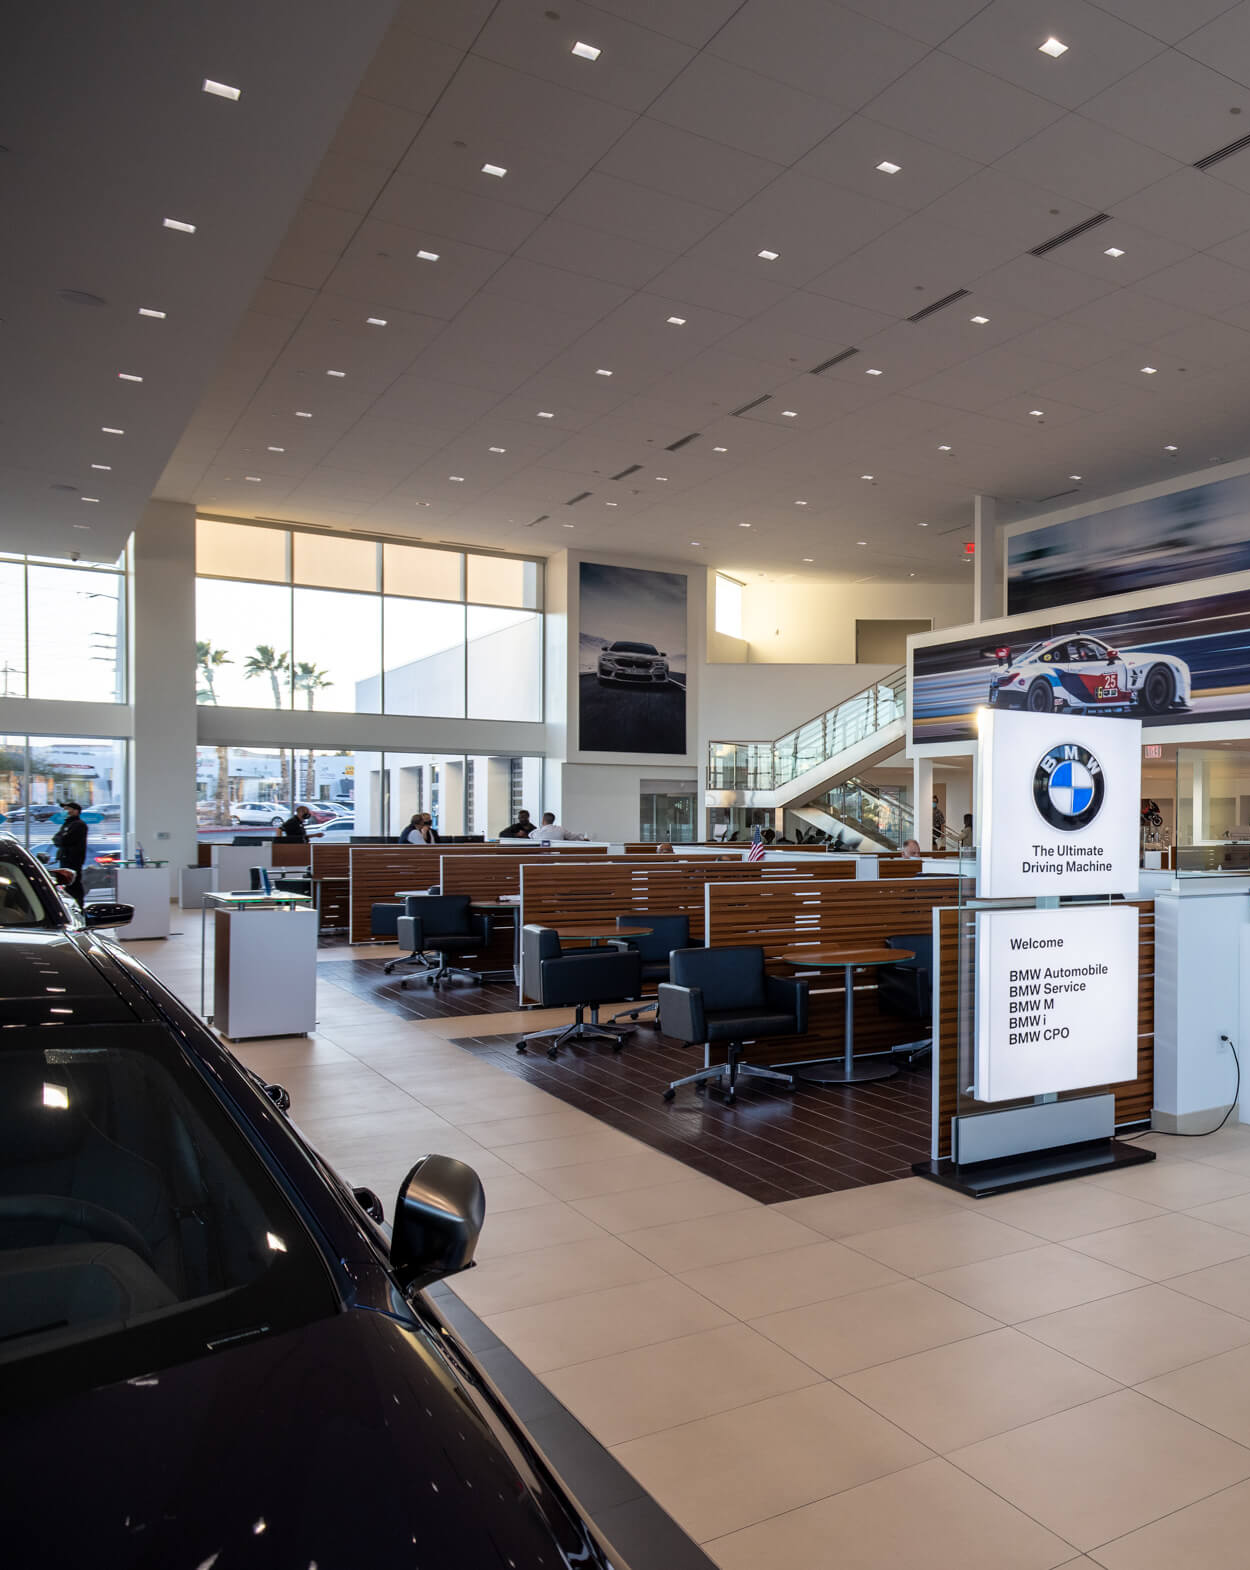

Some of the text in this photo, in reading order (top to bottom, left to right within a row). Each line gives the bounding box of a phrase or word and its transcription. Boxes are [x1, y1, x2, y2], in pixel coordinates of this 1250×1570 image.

[1105, 676, 1116, 688] 25
[1040, 746, 1101, 775] BMW
[1032, 845, 1104, 856] The Ultimate
[1022, 860, 1112, 875] Driving Machine
[1010, 938, 1064, 950] Welcome
[1009, 964, 1108, 982] BMW Automobile
[1009, 981, 1086, 997] BMW Service
[1009, 998, 1054, 1013] BMW M
[1009, 1014, 1046, 1029] BMW i
[1009, 1027, 1070, 1045] BMW CPO
